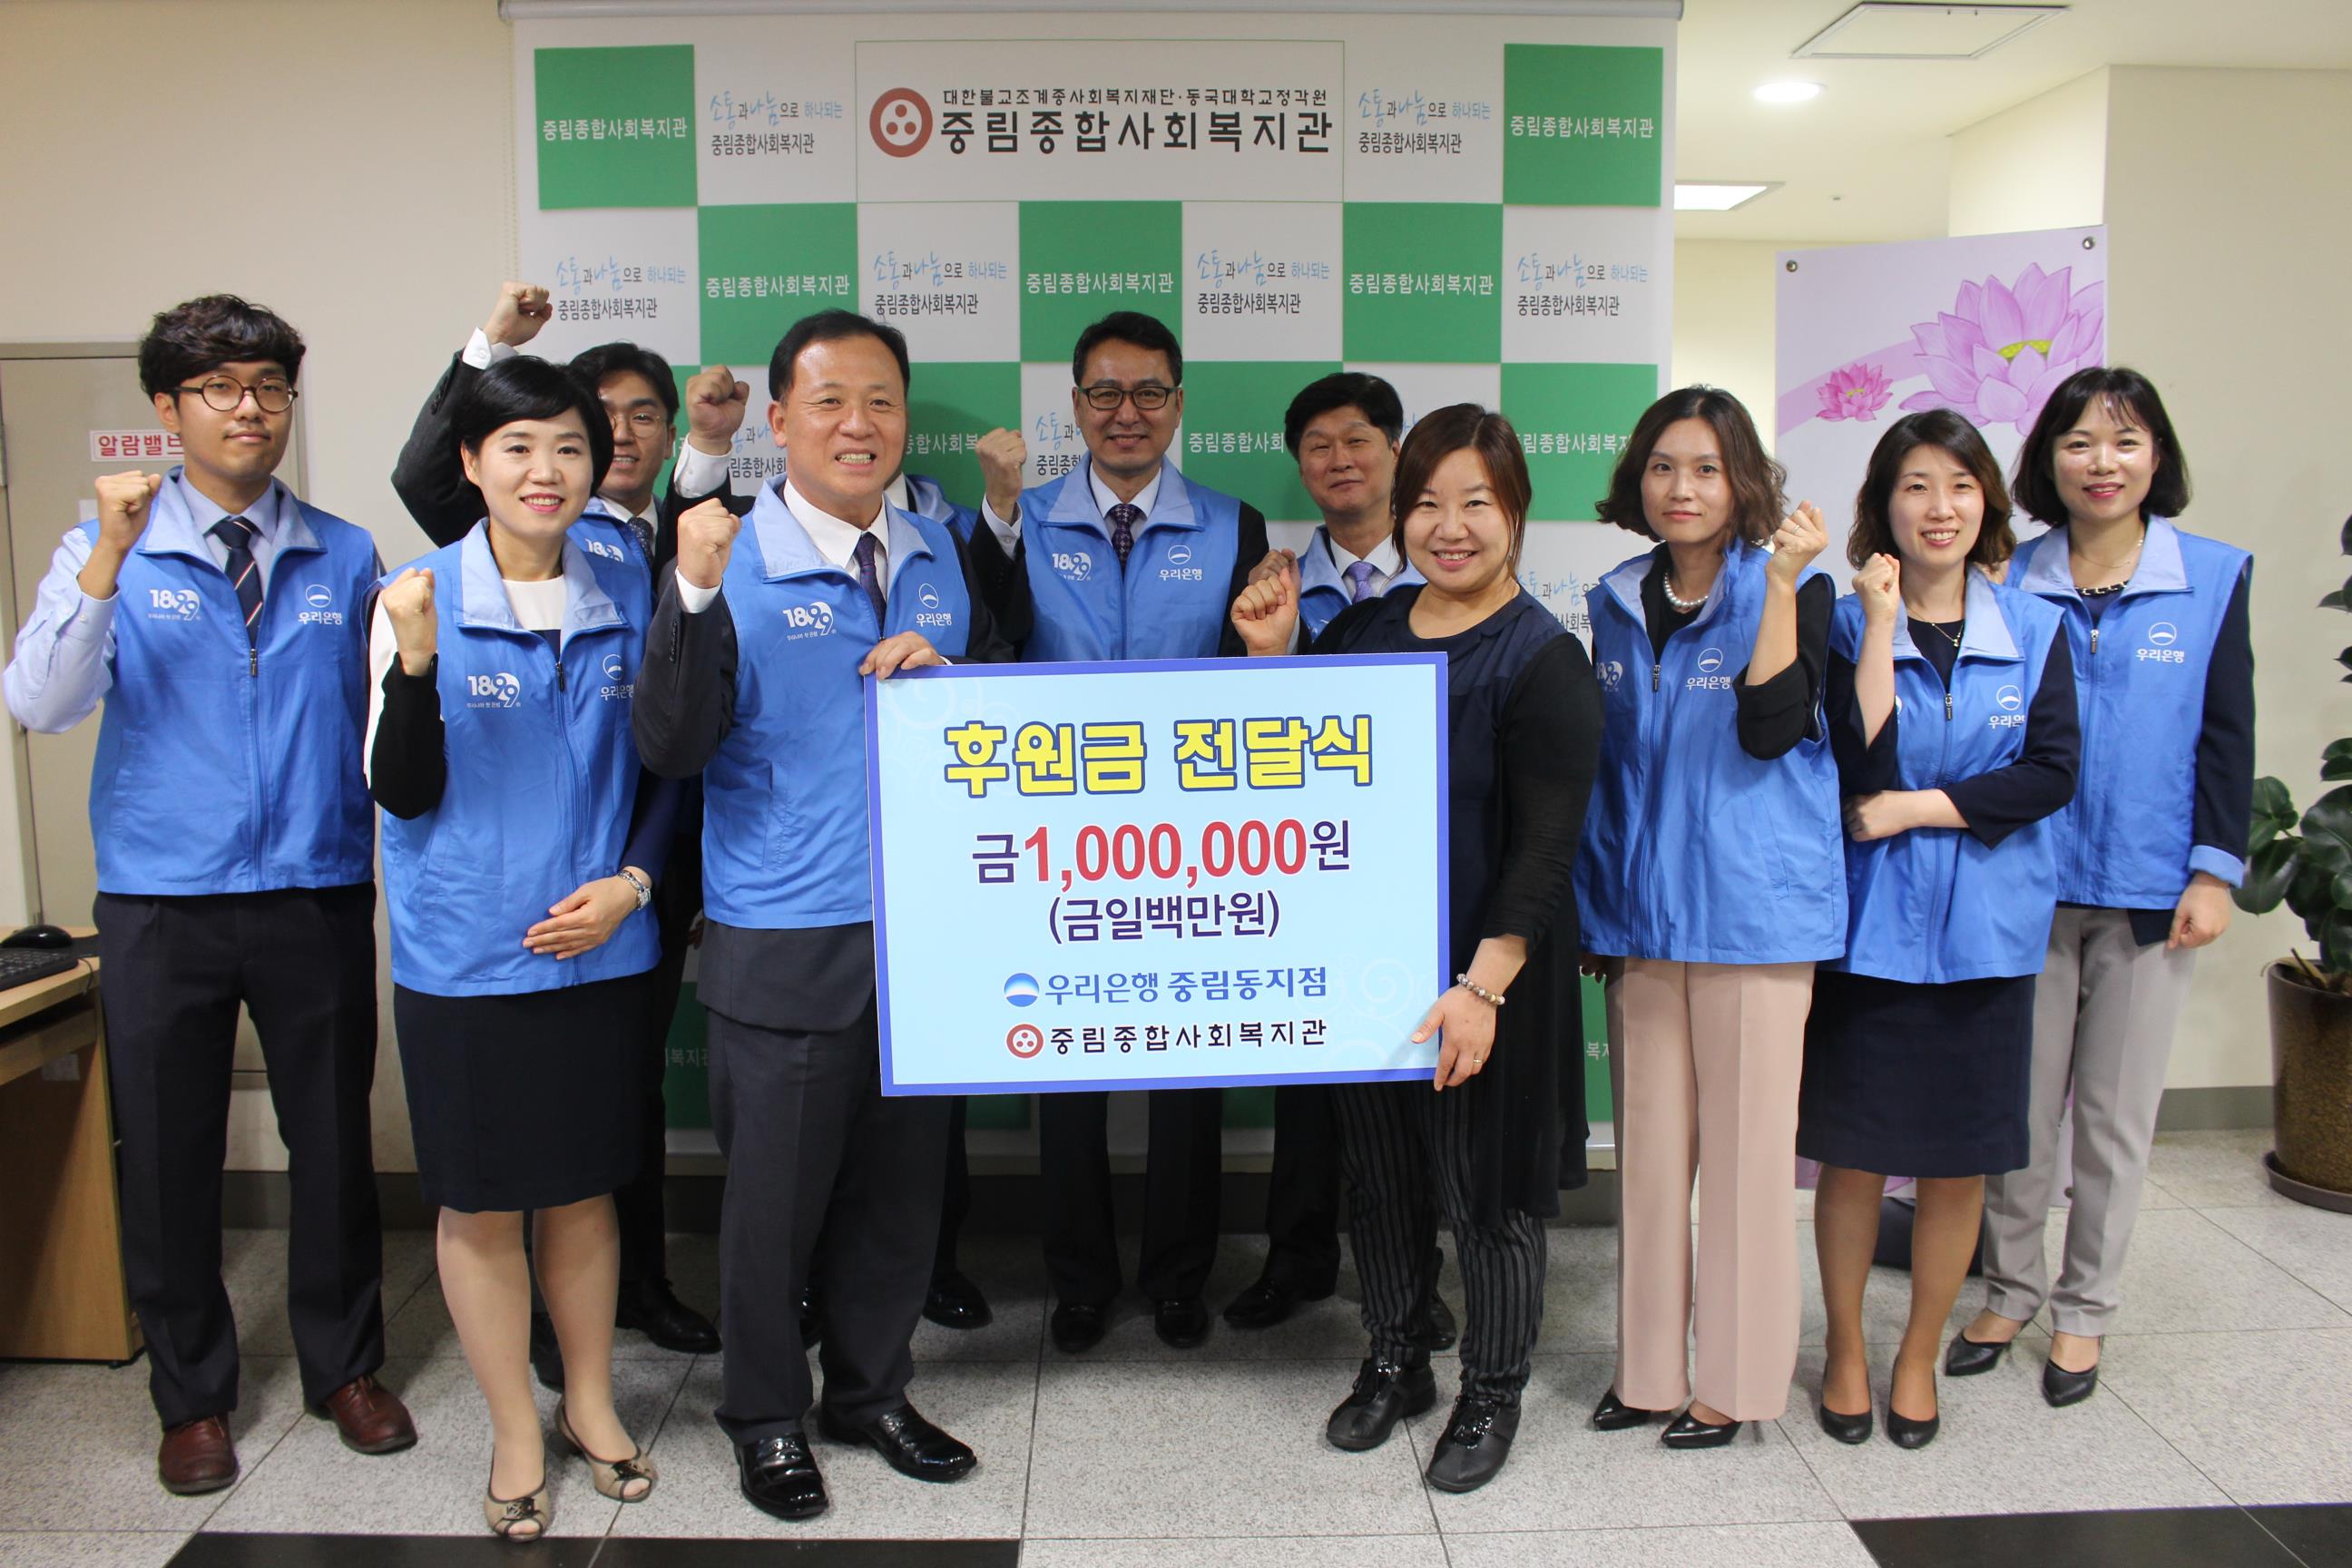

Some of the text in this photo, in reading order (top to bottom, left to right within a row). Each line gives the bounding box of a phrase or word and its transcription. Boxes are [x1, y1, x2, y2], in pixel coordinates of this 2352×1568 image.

[543, 117, 688, 141] 중림종합사회복지관
[941, 112, 1332, 154] 중림종합사회복지관
[1510, 113, 1654, 139] 중림종합사회복지관
[711, 133, 815, 156] 중림종합사회복지관
[1358, 132, 1462, 154] 중림종합사회복지관
[706, 275, 849, 298] 중림종합사회복지관
[1025, 270, 1174, 296] 중림종합사회복지관
[1349, 272, 1494, 297] 중림종합사회복지관
[558, 298, 658, 321] 중림종합사회복지관
[875, 293, 979, 315] 중림종합사회복지관
[1198, 292, 1301, 314] 중림종합사회복지관
[1517, 295, 1620, 317] 중림종합사회복지관
[1189, 432, 1285, 454] 중림종합사회
[1516, 433, 1632, 455] 림종합사회복지
[729, 456, 787, 478] 림종합사회
[1159, 567, 1203, 582] 우리은행
[149, 589, 201, 621] 1899
[298, 611, 343, 625] 우리은행
[783, 601, 834, 636] 1899
[916, 612, 953, 627] 우리은행
[2135, 648, 2185, 663] 우리은행
[467, 671, 521, 708] 1899
[1685, 675, 1731, 691] 우리은행
[945, 714, 1373, 798] 후원금 전달식
[1048, 890, 1280, 945] (금일백만원)
[1045, 965, 1328, 1007] 우리은행 중림동지점
[1050, 1019, 1328, 1054] 중림종합사회복지관
